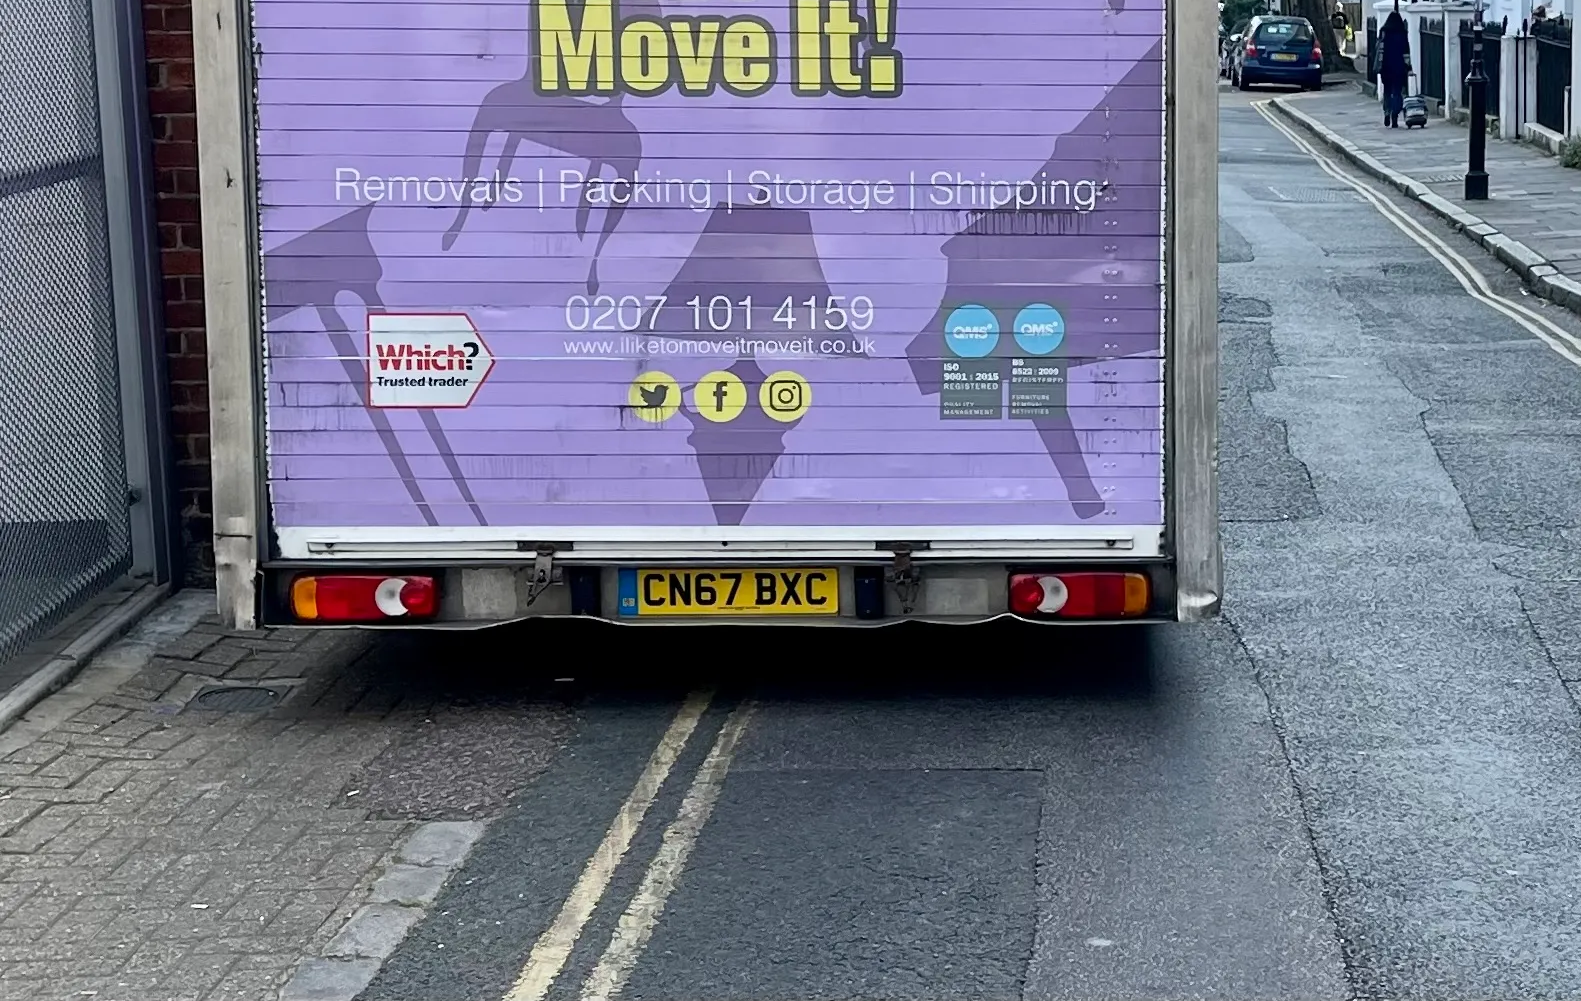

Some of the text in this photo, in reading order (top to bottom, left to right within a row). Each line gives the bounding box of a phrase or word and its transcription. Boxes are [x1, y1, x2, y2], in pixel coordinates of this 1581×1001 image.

[335, 167, 523, 203] Removals
[559, 168, 712, 213] Packing
[747, 169, 895, 214] Storage
[929, 171, 1098, 213] Shipping
[565, 295, 875, 332] 0207 101 4159
[563, 336, 877, 355] www.iliketomoveitmoveit.co.uk
[376, 342, 479, 370] Which?
[944, 362, 960, 371] ISO
[376, 376, 469, 387] Trusted trader
[944, 372, 968, 381] 9001
[975, 372, 1000, 381] 2015
[944, 382, 999, 390] REGISTERED
[643, 572, 828, 607] CN67 BXC
